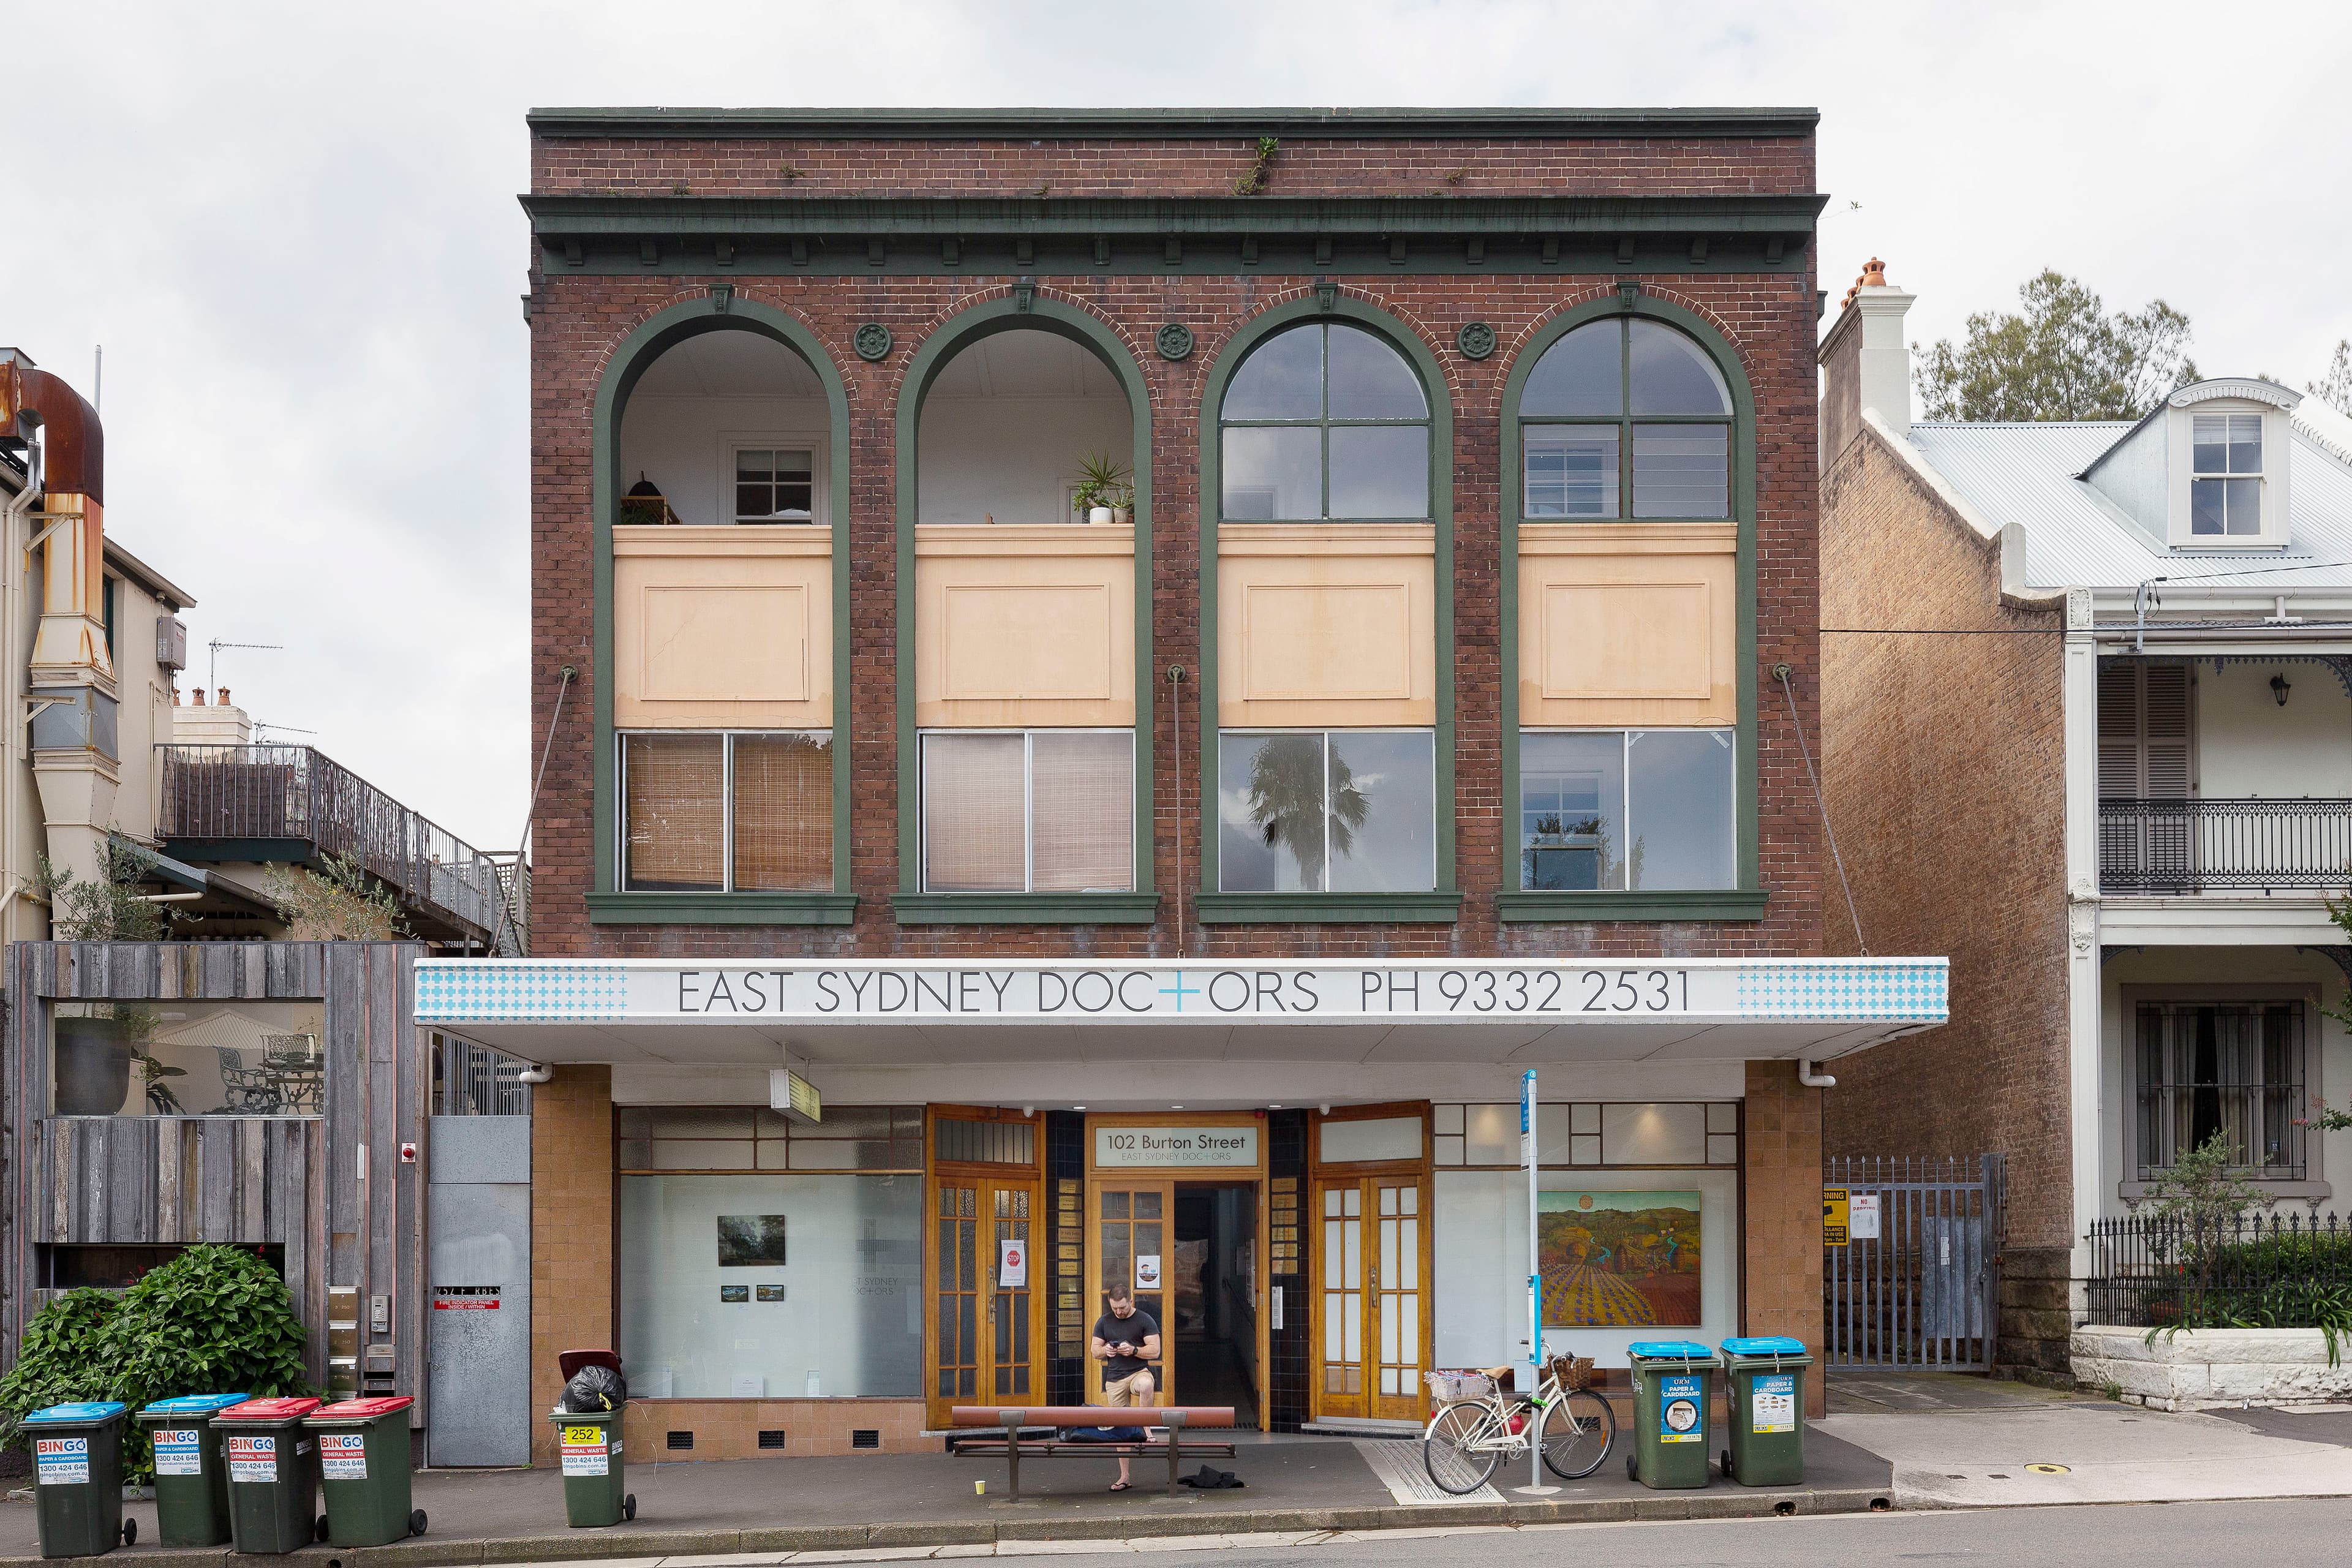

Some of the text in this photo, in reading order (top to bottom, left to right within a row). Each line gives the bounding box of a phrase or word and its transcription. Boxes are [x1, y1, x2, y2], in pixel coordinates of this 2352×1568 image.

[679, 971, 794, 1012] EAST
[815, 971, 1015, 1012] SYDNEY
[1362, 971, 1418, 1011] PH
[1438, 971, 1561, 1011] 9332
[1581, 971, 1687, 1011] 2531
[1107, 1134, 1245, 1149] 102 Burton Street
[155, 1431, 197, 1442] BINGO
[571, 1429, 594, 1439] 252
[39, 1441, 86, 1452] BINGO
[230, 1439, 274, 1450] BINGO
[296, 1439, 312, 1450] BINGO
[321, 1436, 362, 1447] BINGO
